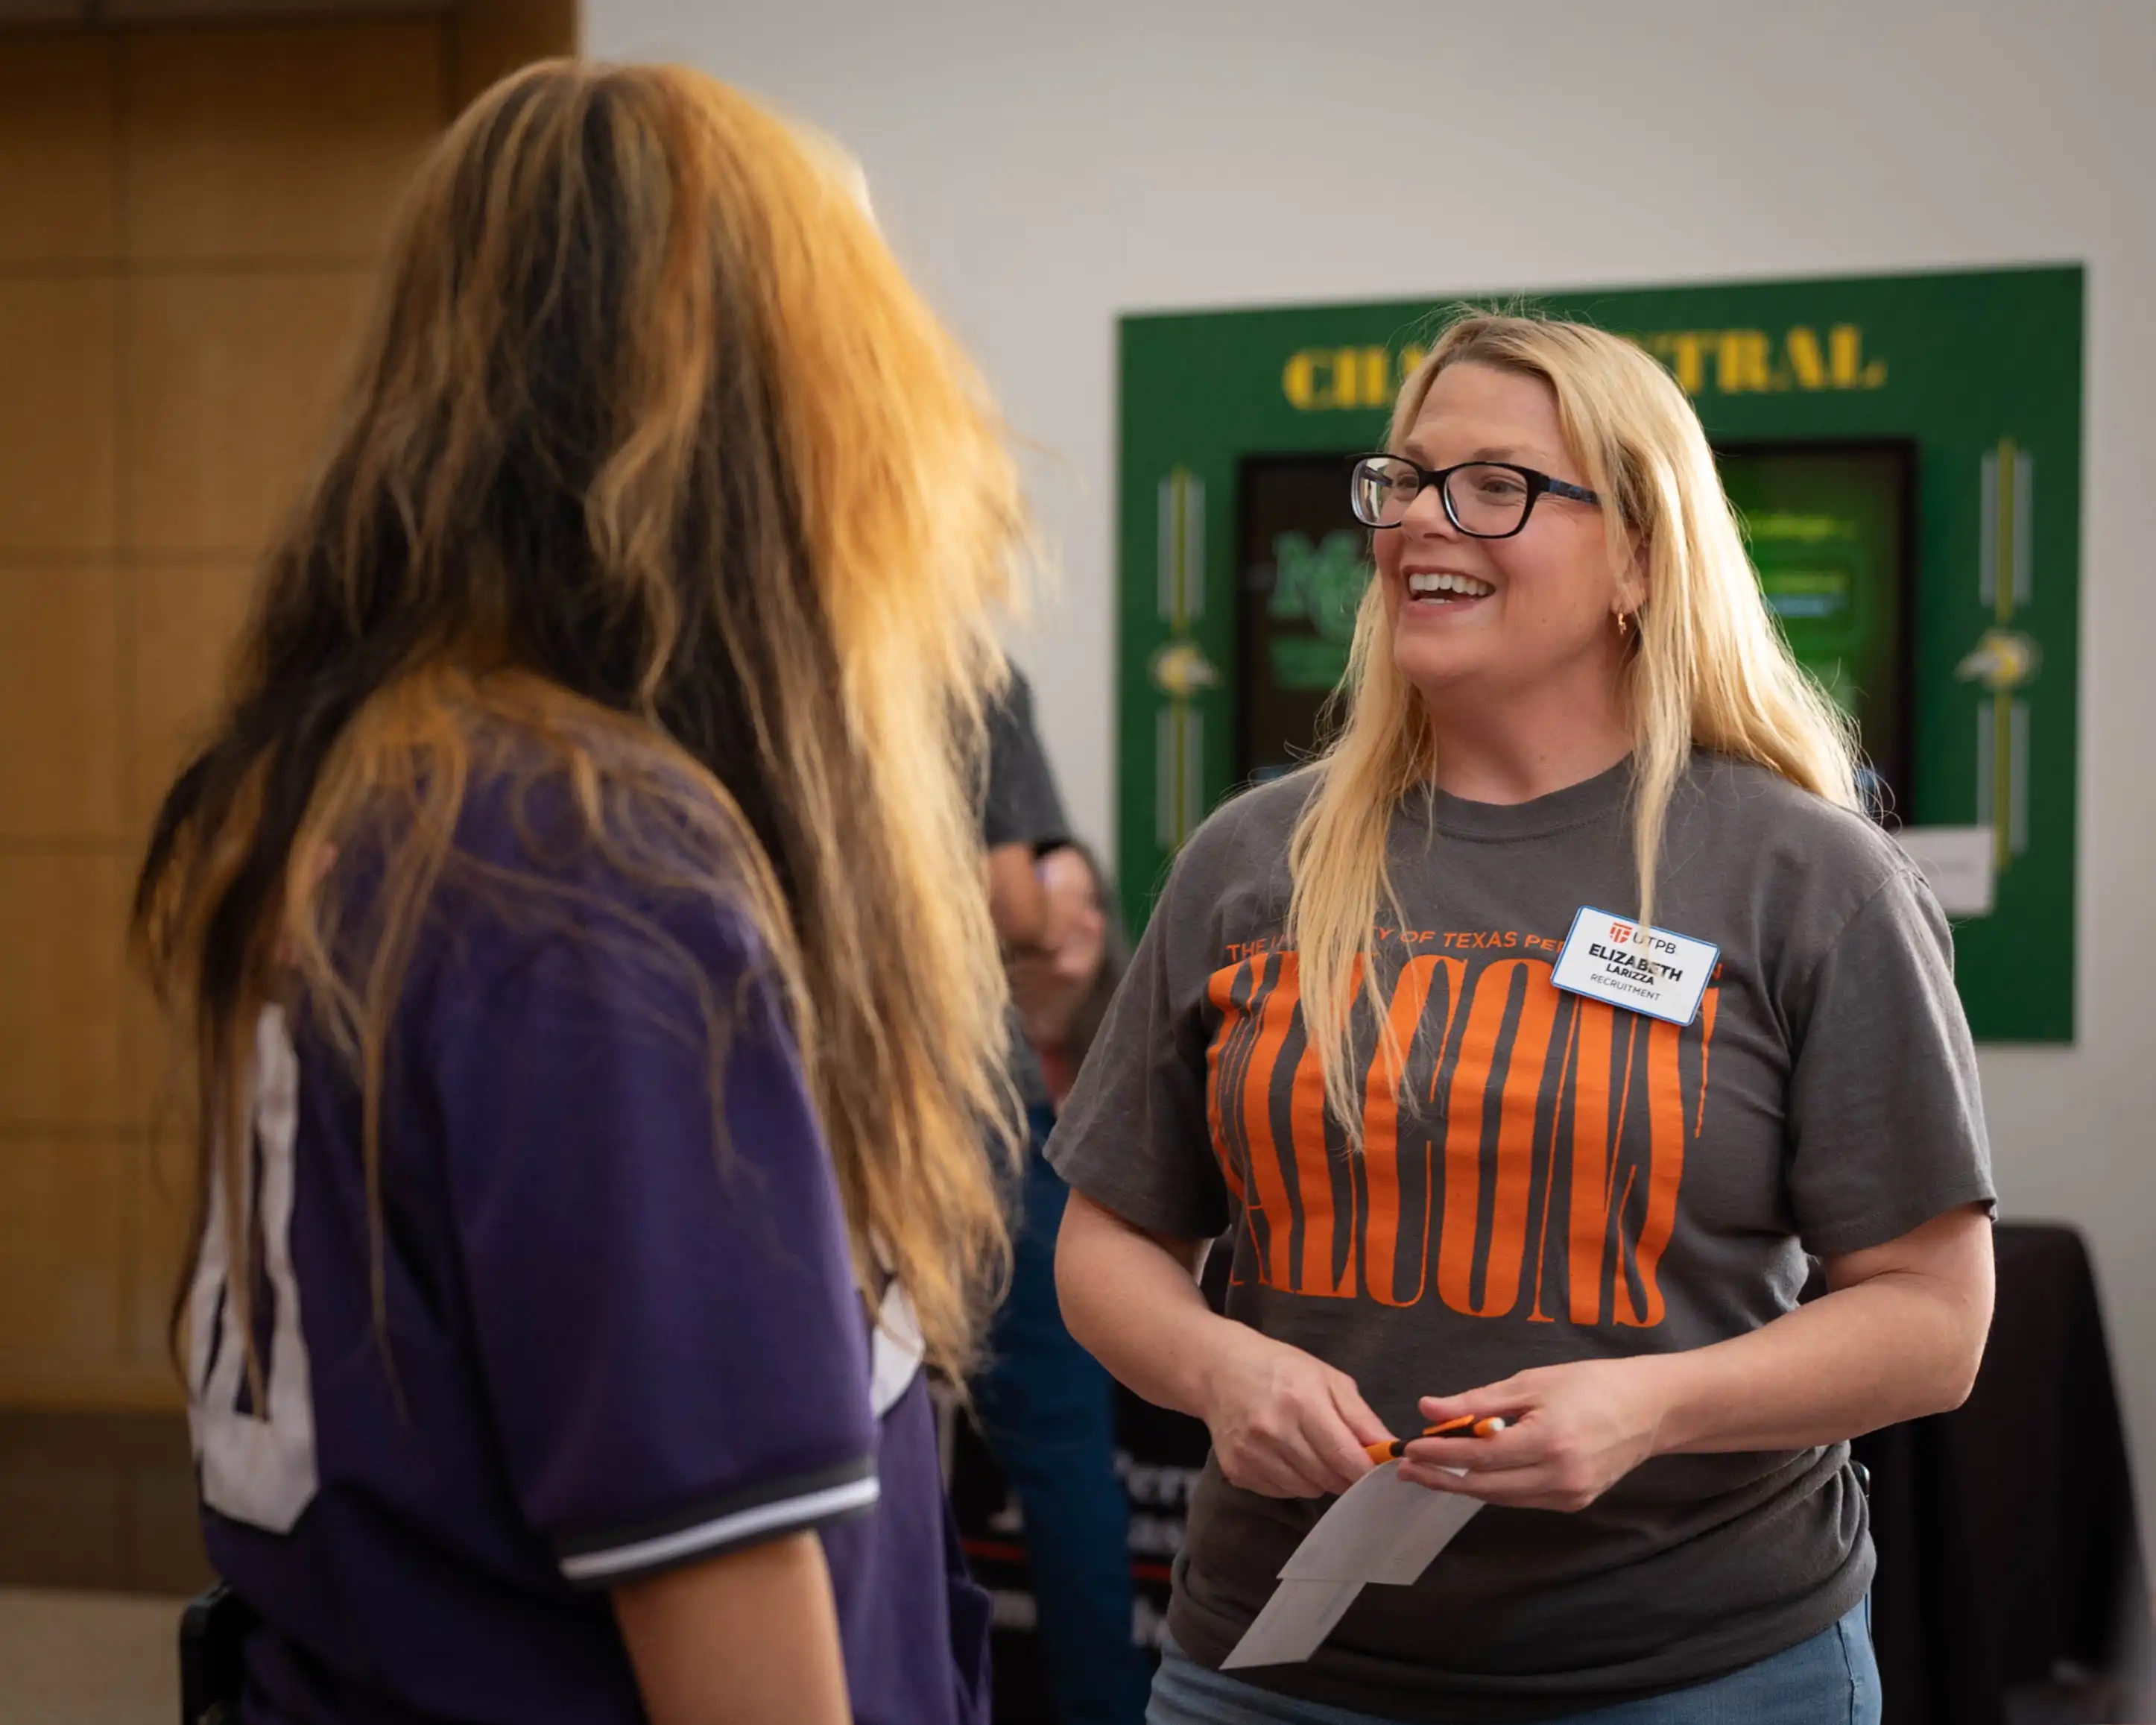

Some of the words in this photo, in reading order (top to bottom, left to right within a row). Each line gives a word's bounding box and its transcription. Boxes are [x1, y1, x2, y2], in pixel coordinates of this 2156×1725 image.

[1225, 937, 1267, 962] THE
[1400, 930, 1436, 944] OF
[1443, 930, 1518, 950] TEXAS
[1632, 931, 1677, 955] UTPB
[1588, 943, 1684, 983] ELIZABETH
[1605, 963, 1655, 986] LARIZZA
[1590, 974, 1661, 1002] RECRUITMENT
